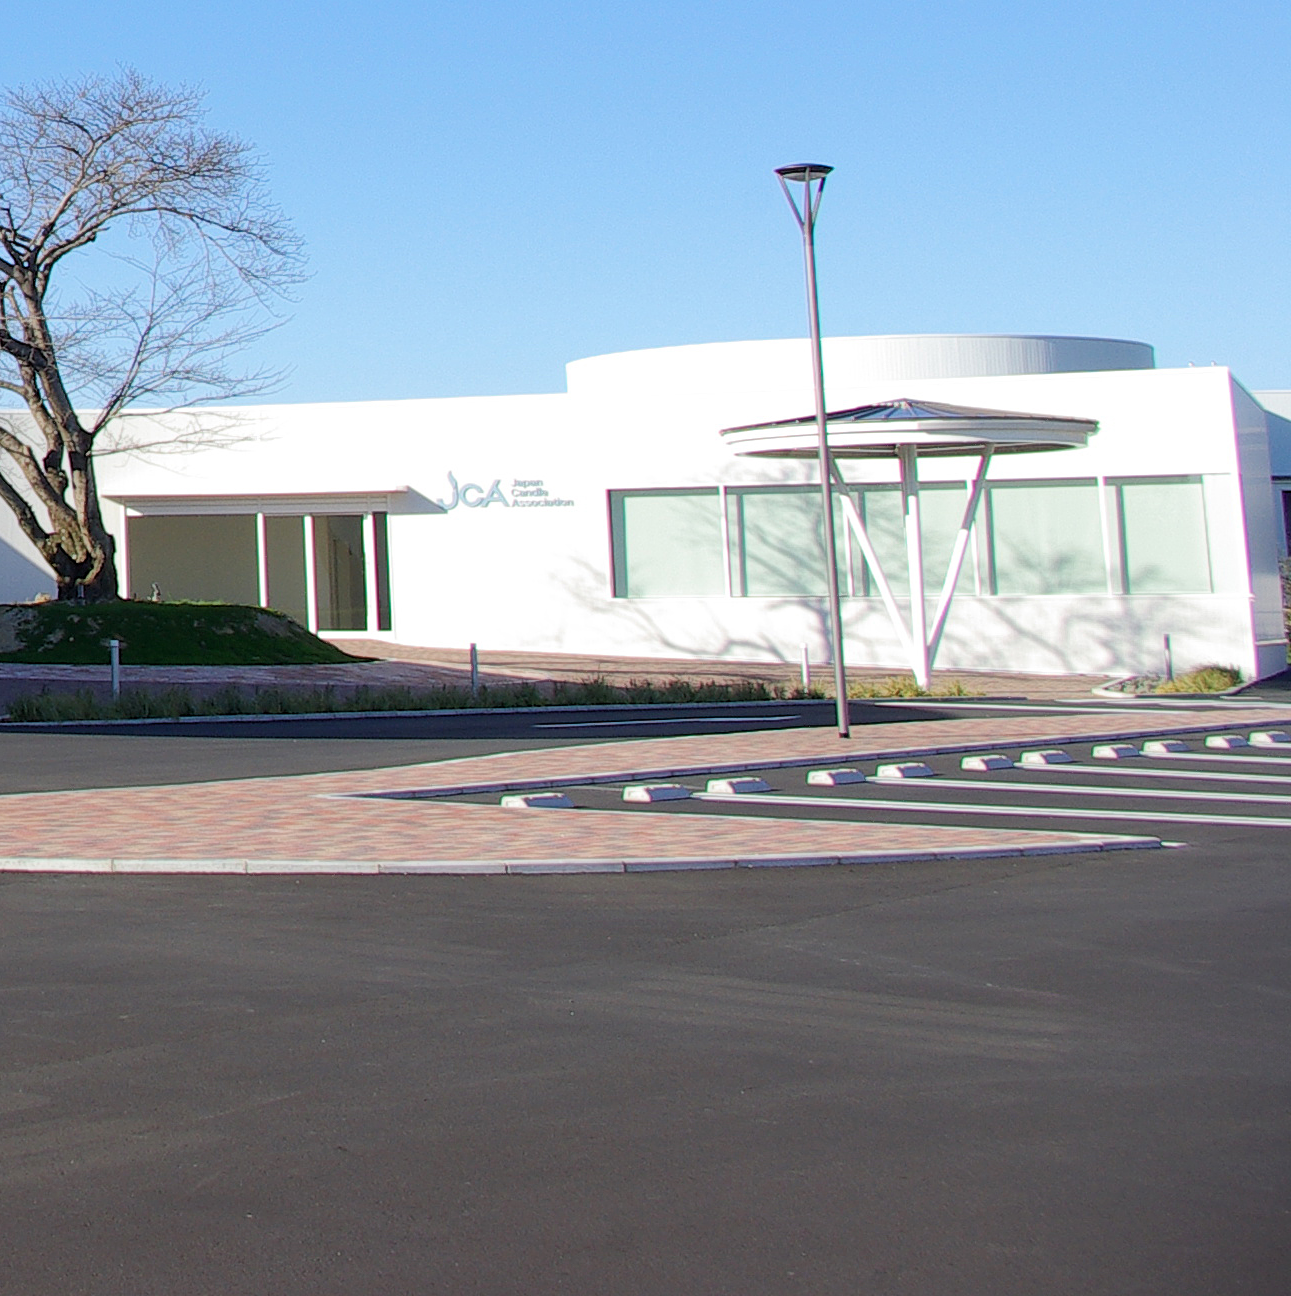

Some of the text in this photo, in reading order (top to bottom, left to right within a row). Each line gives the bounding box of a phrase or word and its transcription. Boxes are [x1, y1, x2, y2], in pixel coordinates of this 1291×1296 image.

[511, 478, 544, 488] Japan
[436, 470, 510, 511] JCA
[511, 488, 549, 497] Candle
[511, 498, 575, 508] Association
